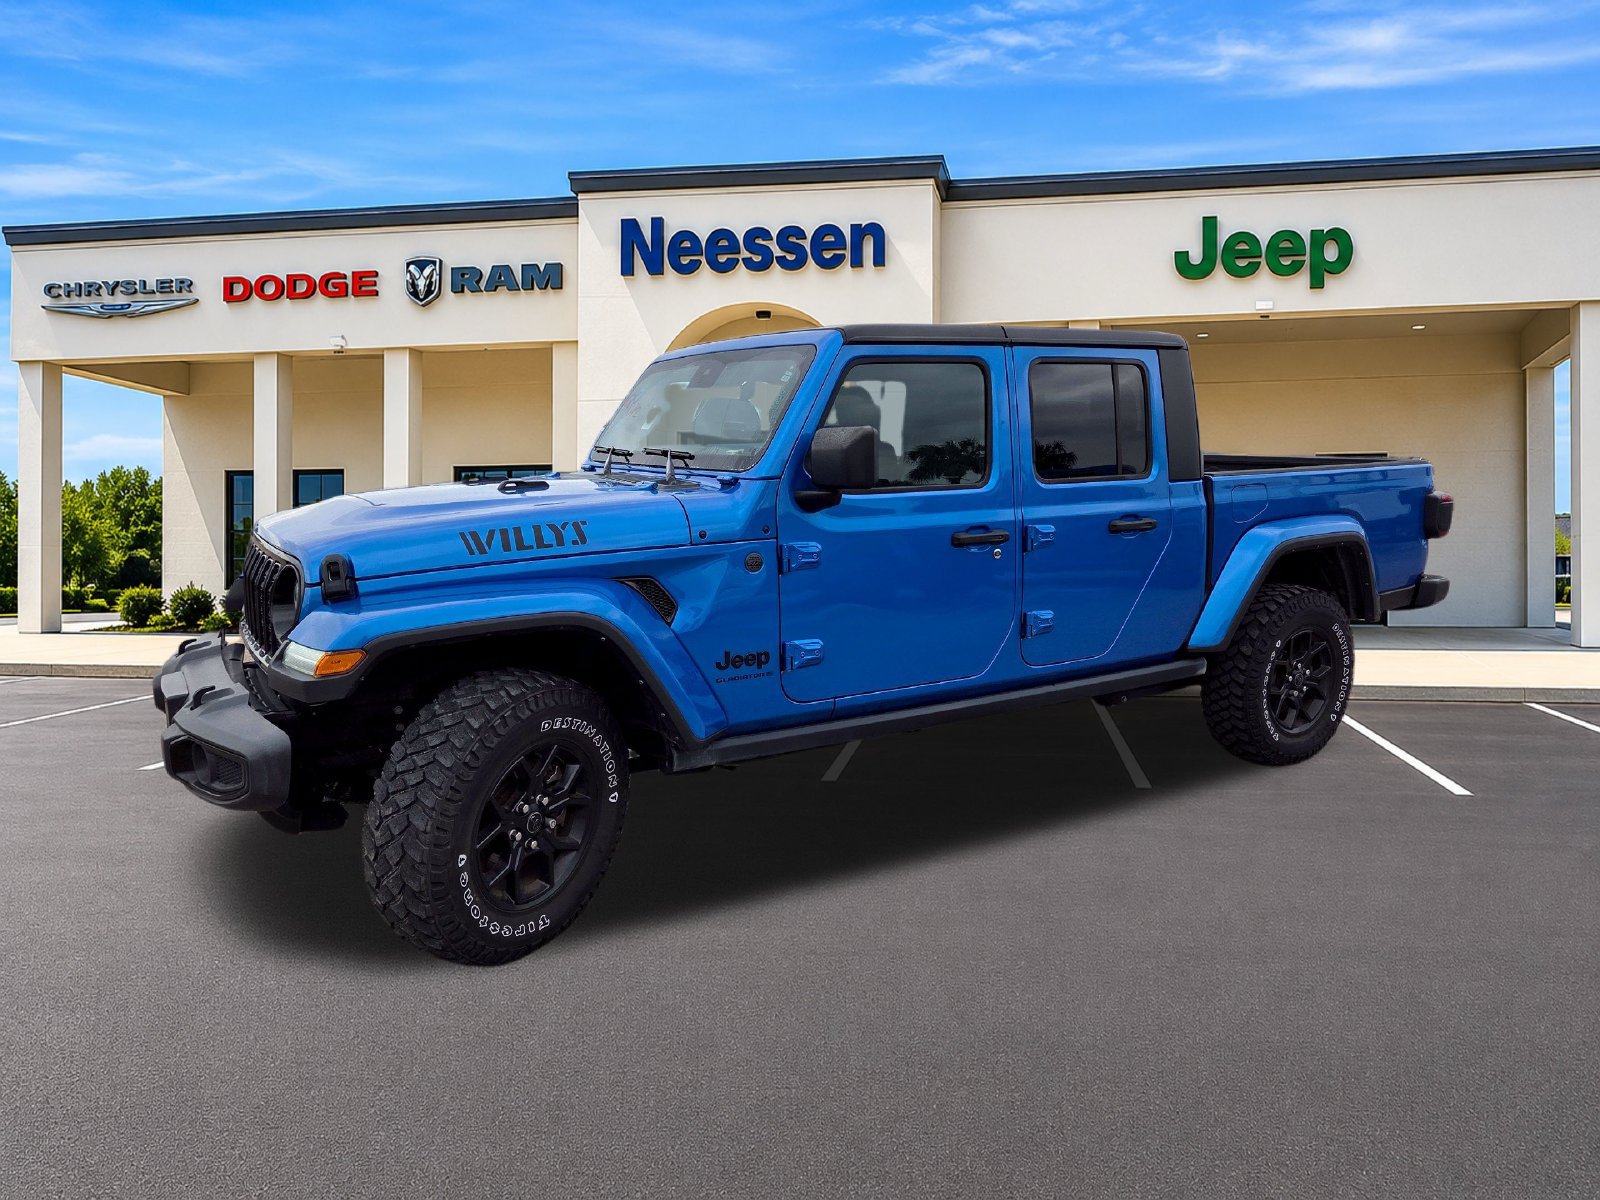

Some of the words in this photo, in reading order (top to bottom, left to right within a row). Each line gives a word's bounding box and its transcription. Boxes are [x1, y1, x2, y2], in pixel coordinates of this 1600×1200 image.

[620, 216, 886, 276] Neessen
[1174, 215, 1354, 290] Jeep
[43, 276, 193, 297] CHRYSLER
[222, 270, 379, 303] DODGE
[450, 262, 563, 294] RAM
[459, 520, 588, 556] WILLYS
[715, 650, 771, 671] Jeep
[540, 717, 618, 788] DESTINATION
[459, 872, 550, 937] Firestone
